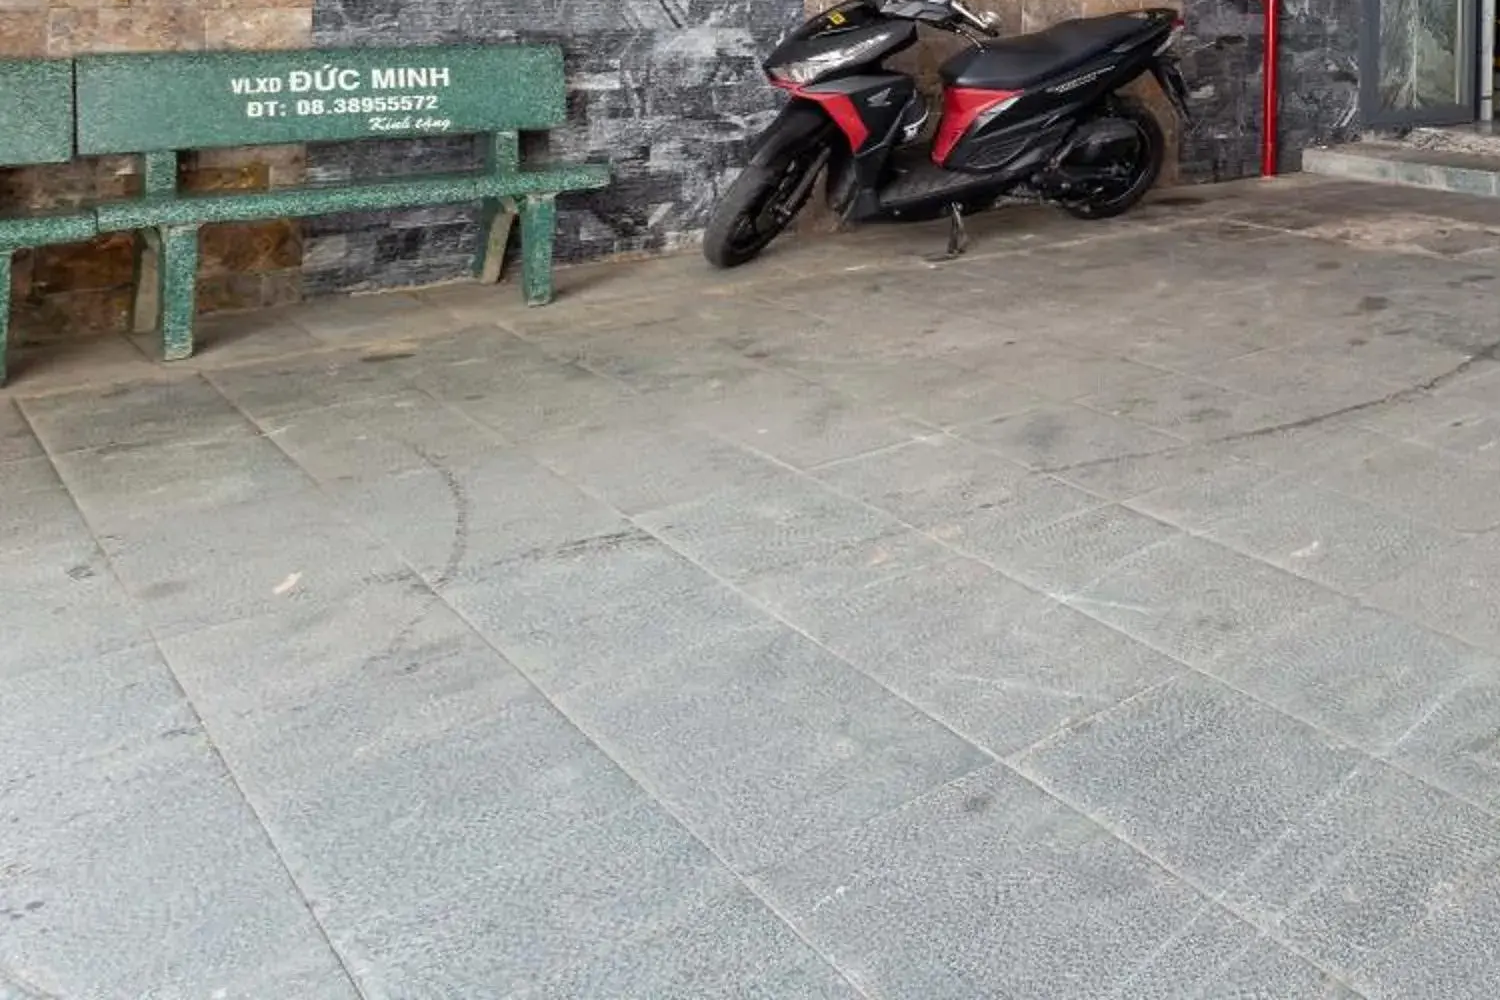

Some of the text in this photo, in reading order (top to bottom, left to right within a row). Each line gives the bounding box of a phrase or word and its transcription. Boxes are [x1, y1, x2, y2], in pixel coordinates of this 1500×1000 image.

[231, 64, 450, 94] VLXD ĐỨC MINH
[247, 95, 439, 117] ĐT: 08.38955572
